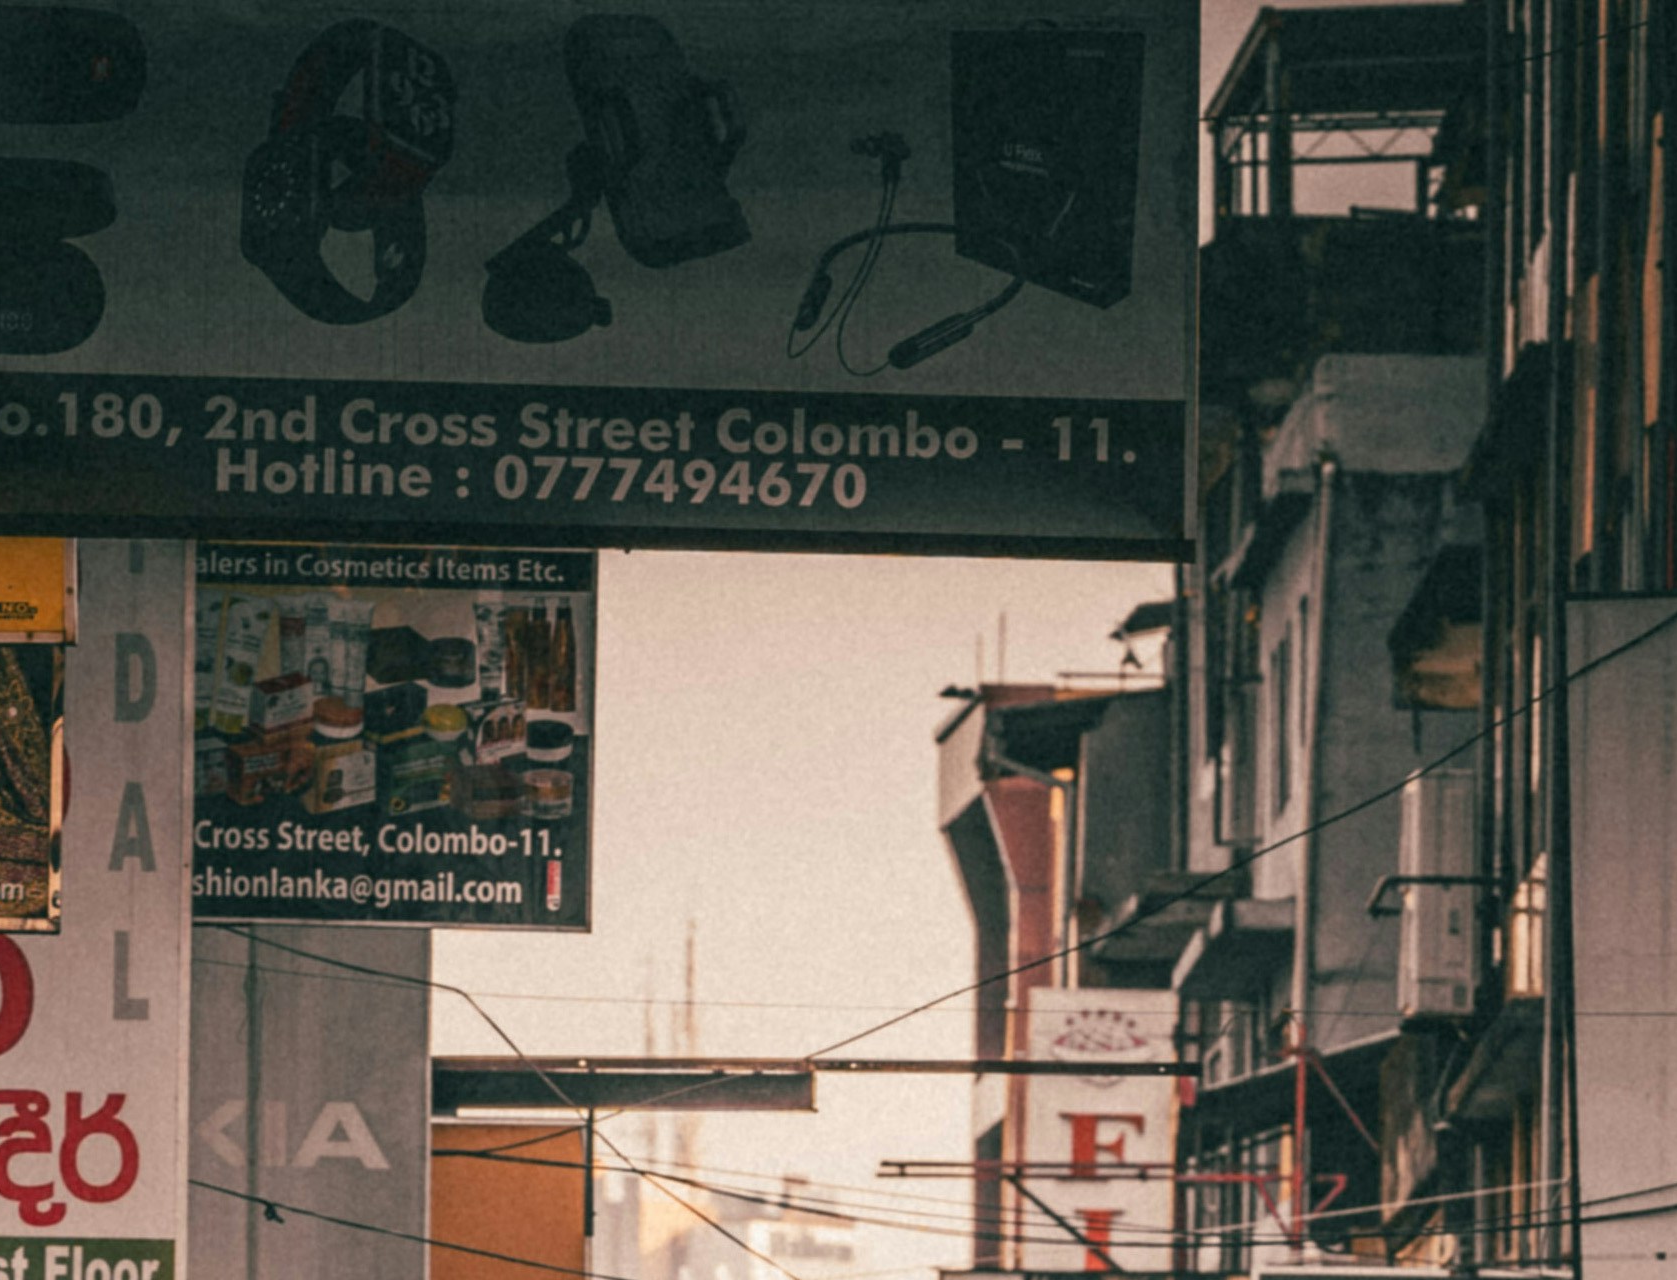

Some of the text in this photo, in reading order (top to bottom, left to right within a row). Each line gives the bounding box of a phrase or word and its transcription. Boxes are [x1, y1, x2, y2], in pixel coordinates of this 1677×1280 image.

[204, 394, 317, 444] 2nd
[340, 397, 498, 449] Cross
[520, 399, 695, 456] Street
[718, 403, 980, 460] Colombo
[1052, 417, 1137, 463] 11.
[215, 452, 869, 511] Hotline 0777494670
[264, 554, 287, 577] in
[295, 553, 431, 581] Cosmetics
[438, 555, 511, 582] Items
[518, 557, 565, 583] Etc.
[194, 820, 564, 861] Cross Street, Colombo-11.
